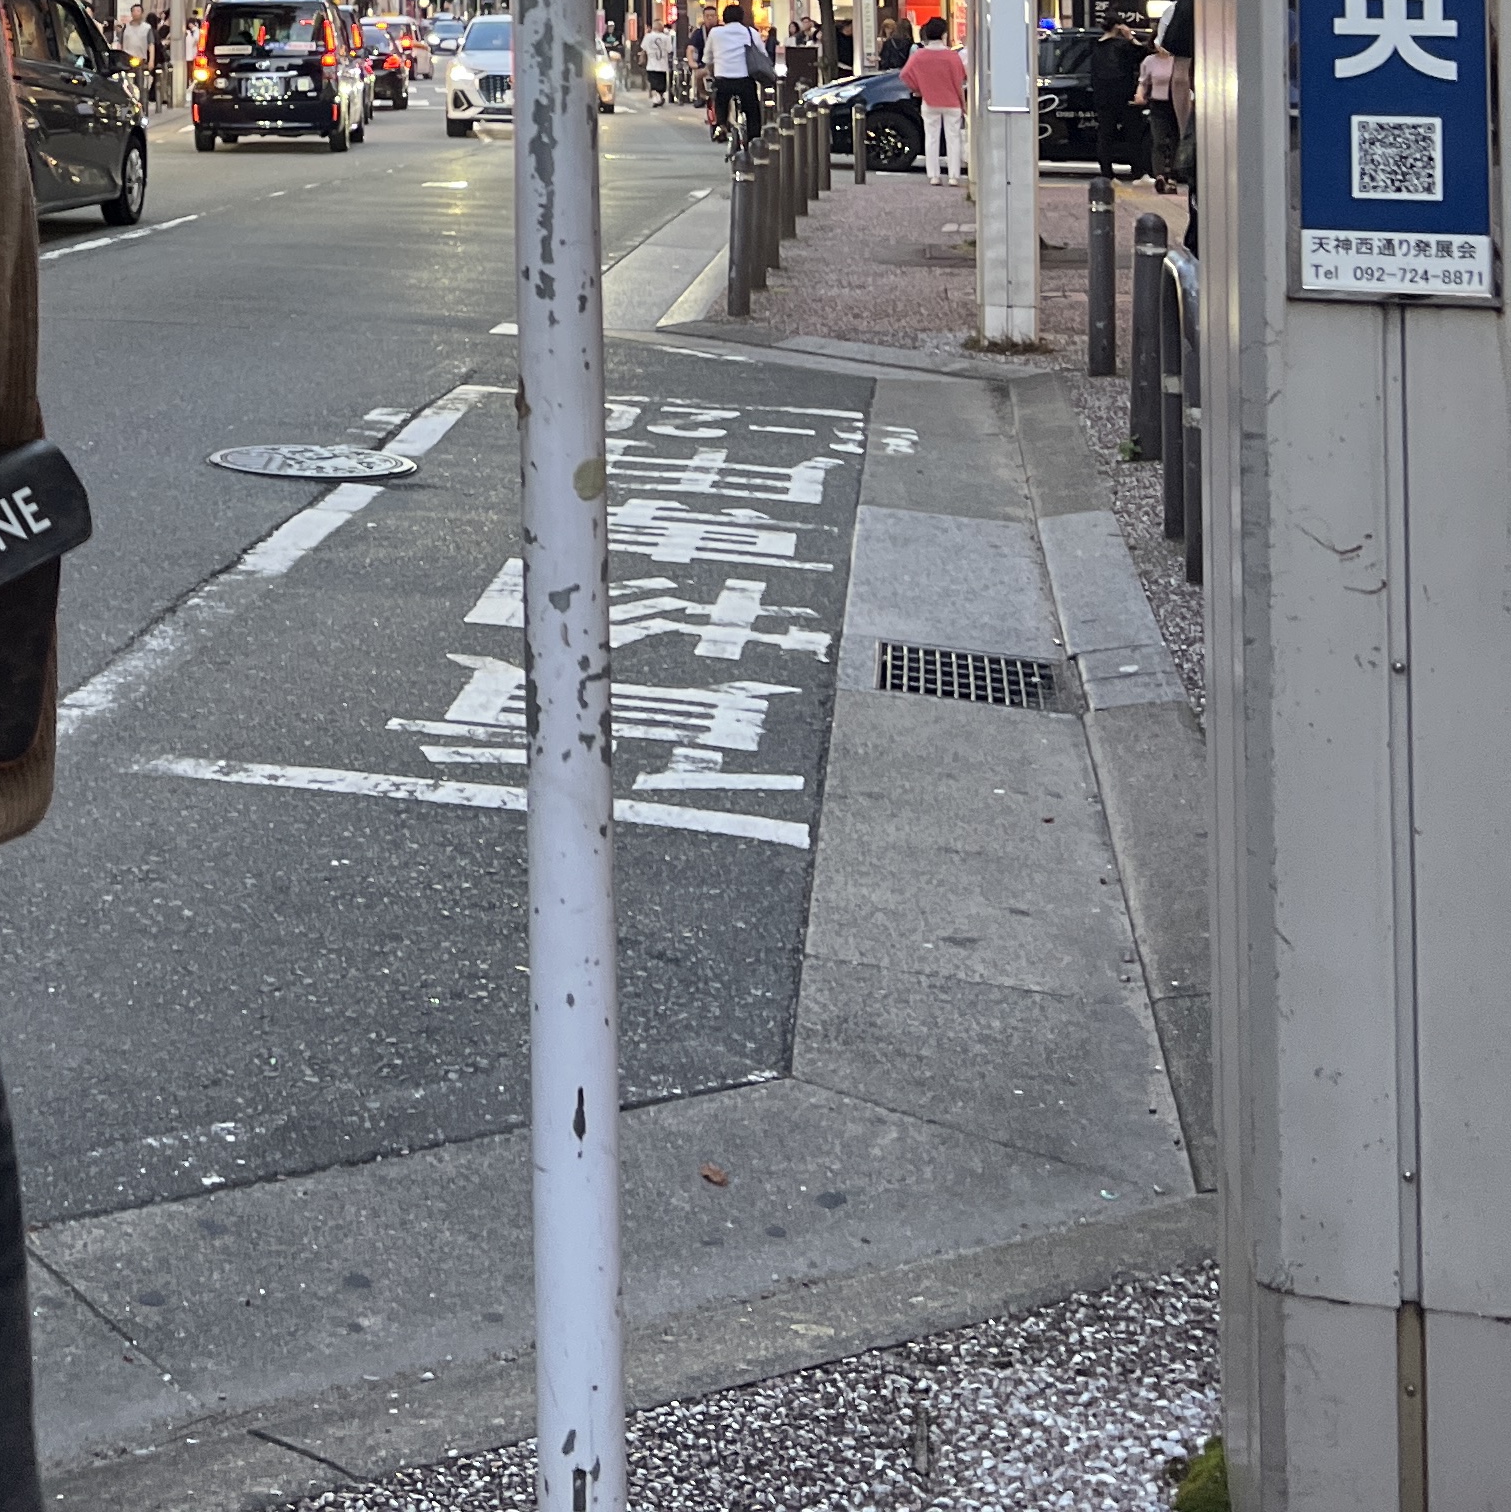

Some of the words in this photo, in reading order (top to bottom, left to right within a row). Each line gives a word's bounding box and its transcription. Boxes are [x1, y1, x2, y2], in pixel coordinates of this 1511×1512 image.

[1095, 1, 1109, 12] 2F
[1311, 235, 1477, 260] 天神西通り発展会
[1311, 264, 1339, 280] Tel
[1352, 265, 1484, 286] 092-724-8871
